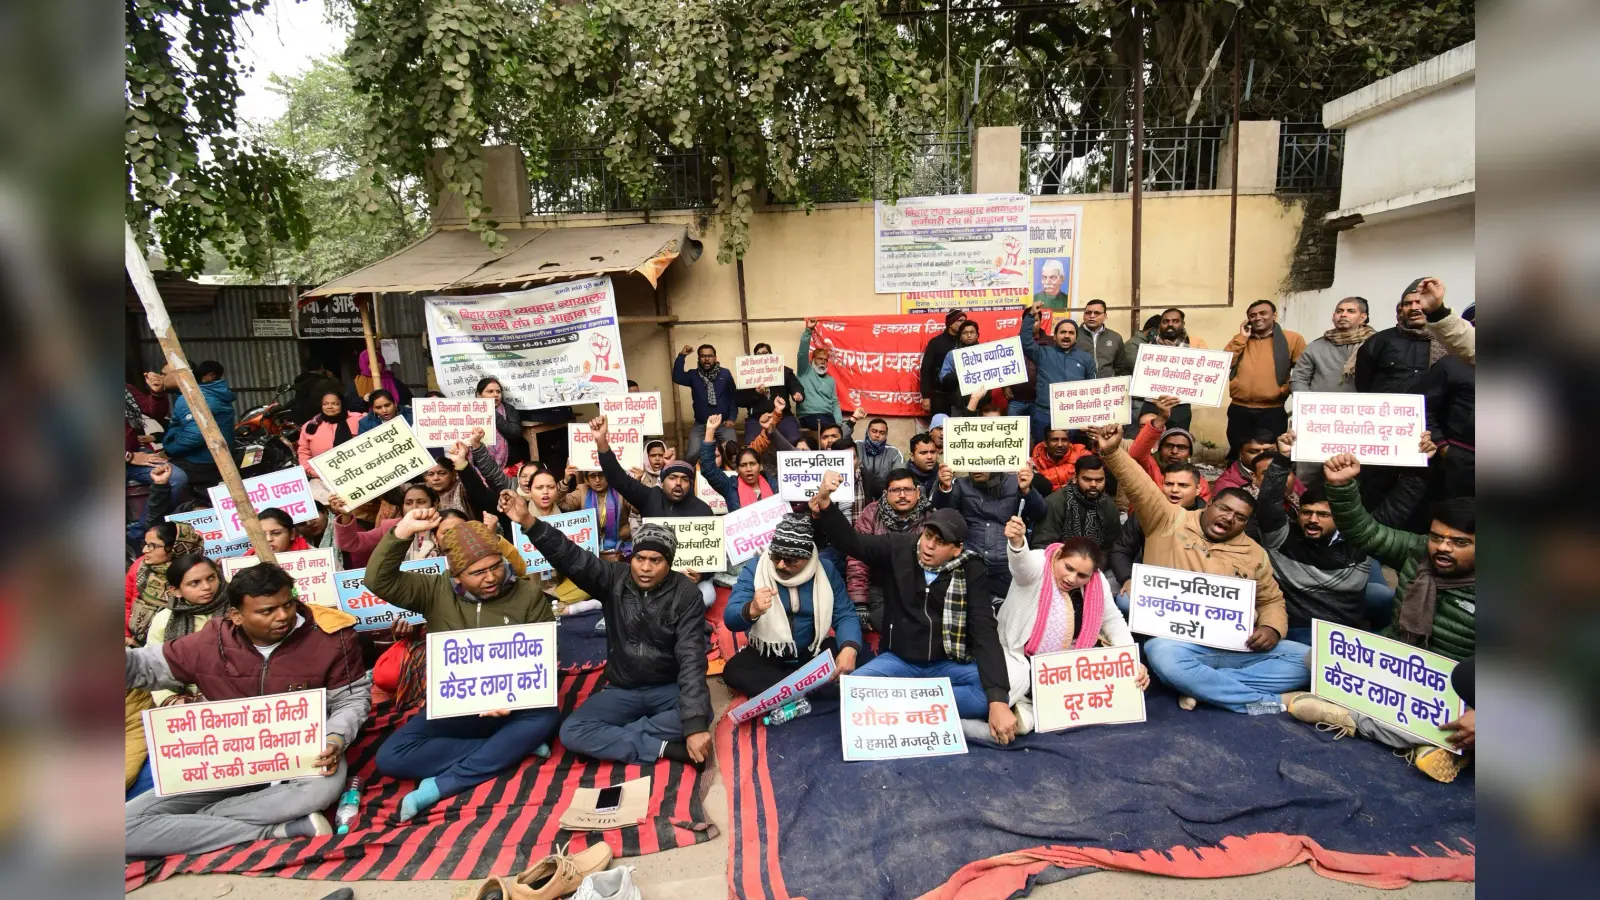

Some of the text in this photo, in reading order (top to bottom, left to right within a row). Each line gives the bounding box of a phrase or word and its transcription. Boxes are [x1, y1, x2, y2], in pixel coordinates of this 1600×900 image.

[459, 291, 606, 320] बिहार राज्य व्यवहार न्यायालय
[471, 318, 509, 331] कर्मचारी
[512, 317, 531, 328] संघ
[533, 313, 545, 325] के
[589, 305, 602, 316] पर
[522, 337, 566, 348] 16.01.2025
[961, 343, 1014, 367] विशेष न्यायिक
[1142, 353, 1206, 367] हम सब का एक ही
[983, 367, 1004, 383] लागू
[1143, 365, 1220, 386] वेतन विसंगति दूर करें
[1054, 383, 1110, 399] हम सब का एक ही
[1150, 384, 1198, 397] सरकार हमारा
[422, 401, 488, 413] सभी विभागों को मिली
[604, 396, 658, 411] वेतन विसंगति
[1059, 395, 1125, 411] वेतन विसंगति दूर करें
[1300, 403, 1317, 416] हम
[1320, 404, 1336, 416] सब
[1340, 404, 1355, 416] का
[1357, 405, 1376, 417] एक
[1379, 401, 1392, 418] ही
[419, 414, 447, 427] पदोन्नति
[448, 417, 464, 426] न्याय
[465, 414, 485, 426] विभाग
[953, 420, 1018, 435] तृतीय एवं चतुर्थ
[1069, 413, 1110, 424] सरकार हमारा
[428, 429, 442, 441] क्यों
[1306, 420, 1415, 441] वेतन विसंगति दूर करें
[326, 424, 400, 471] तृतीय एवं चतुर्थ
[949, 437, 1024, 449] वर्गीय कर्मचारियों
[1321, 443, 1390, 456] सरकार हमारा
[333, 437, 415, 488] वर्गीय कर्मचारियों
[784, 453, 845, 468] शत-प्रतिशत
[952, 455, 1020, 466] को पदोन्नति दें।
[348, 457, 425, 502] को पदोन्नति दें।
[782, 470, 822, 487] अनुकंपा
[271, 478, 305, 499] एकता
[567, 514, 591, 527] हमको
[679, 522, 693, 532] एवं
[694, 520, 716, 535] चतुर्थ
[726, 504, 788, 537] कर्मचारी एकता
[297, 559, 307, 571] ही
[672, 555, 718, 567] दोन्नति दें।
[298, 572, 327, 590] दूर करें
[1143, 573, 1240, 601] शत-प्रतिशत
[365, 610, 394, 625] हमारी
[1137, 593, 1247, 632] अनुकंपा लागू
[1169, 620, 1205, 640] करें।
[443, 632, 544, 667] विशेष न्यायिक
[1038, 652, 1136, 686] वेतन विसंगति
[1329, 630, 1448, 692] विशेष न्यायिक
[439, 663, 548, 702] कैडर लागू करें।
[738, 661, 831, 722] कर्मचारी एकता
[849, 684, 944, 702] हड़ताल का हमको
[1324, 661, 1450, 726] कैडर लागू करें।
[1063, 685, 1115, 721] दूर करें
[166, 697, 309, 734] सभी विभागों को मिली
[851, 704, 949, 727] शौक नहीं
[160, 723, 319, 760] पदोन्नति न्याय विभाग में
[854, 731, 958, 751] ये हमारी मजबूरी है।
[182, 752, 289, 783] क्यों रूकी उन्नति
